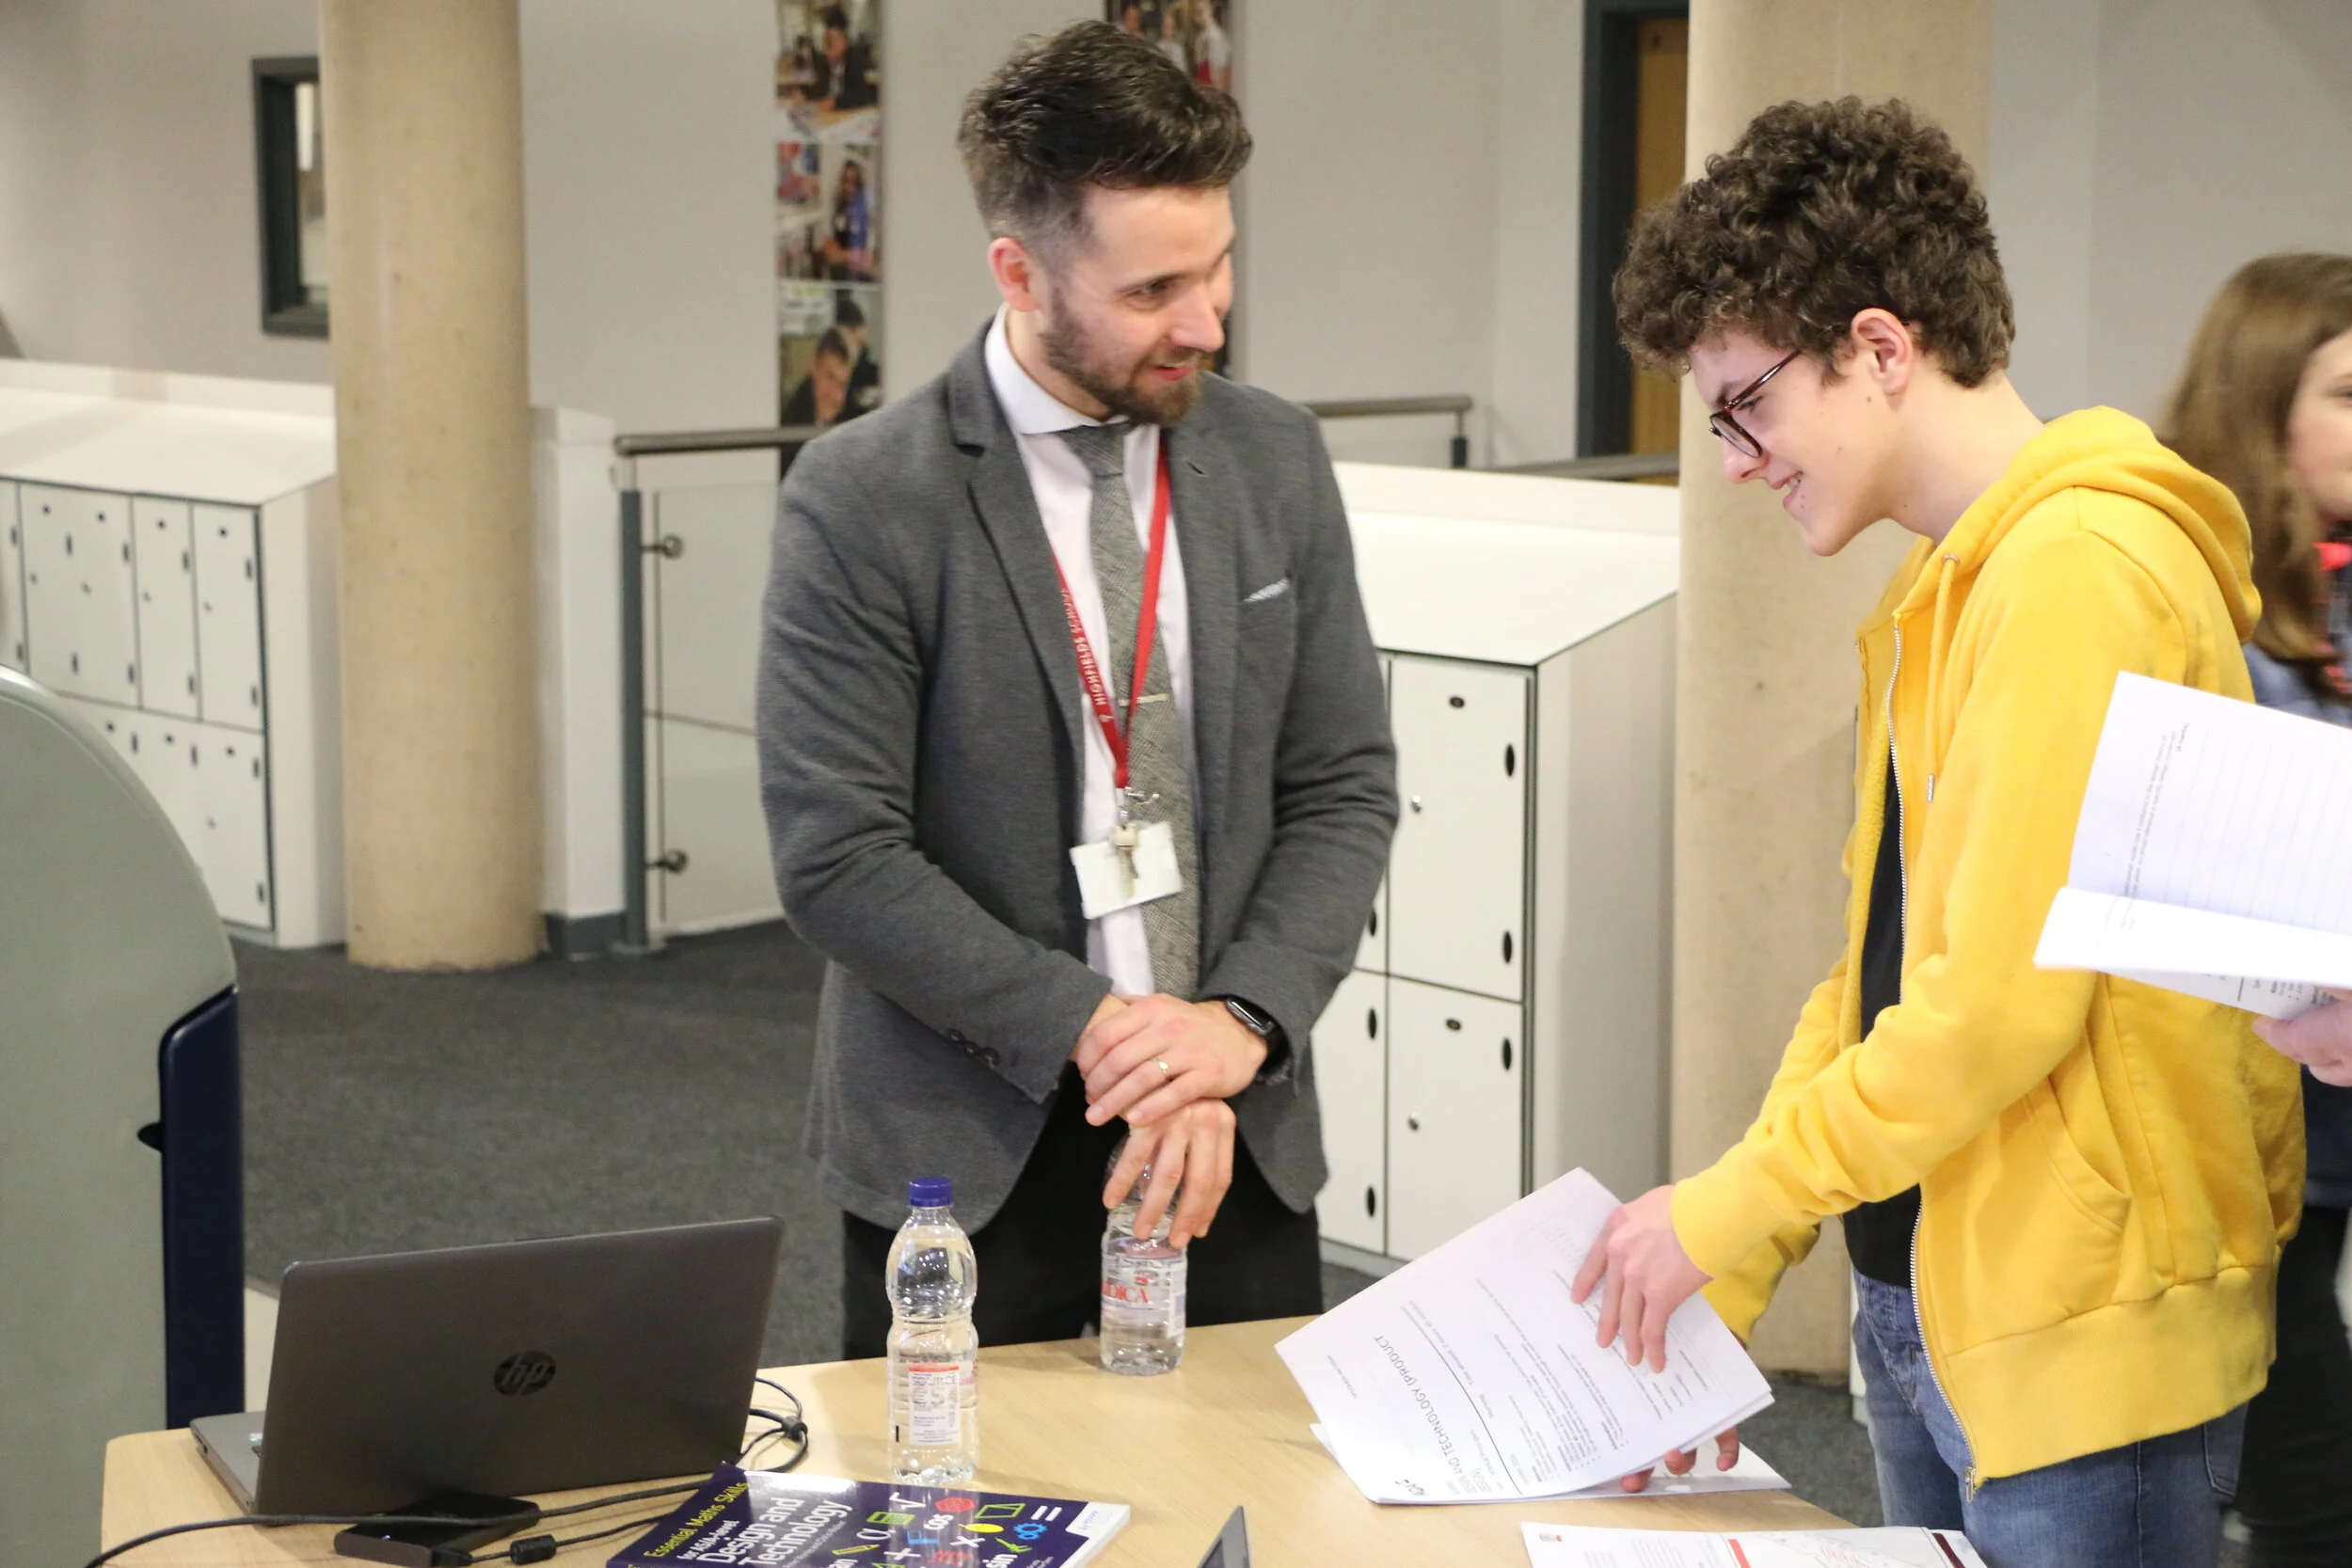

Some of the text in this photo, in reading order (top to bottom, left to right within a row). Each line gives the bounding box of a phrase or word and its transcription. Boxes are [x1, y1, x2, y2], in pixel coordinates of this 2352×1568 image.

[503, 1354, 548, 1396] hp
[1373, 1335, 1417, 1387] (PRODUCT
[1411, 1386, 1454, 1458] TECHNOLOGY
[644, 1481, 751, 1558] Essential Maths Skills
[695, 1513, 779, 1564] Design
[758, 1497, 806, 1523] and
[739, 1498, 854, 1565] Technology
[923, 1513, 955, 1530] cos
